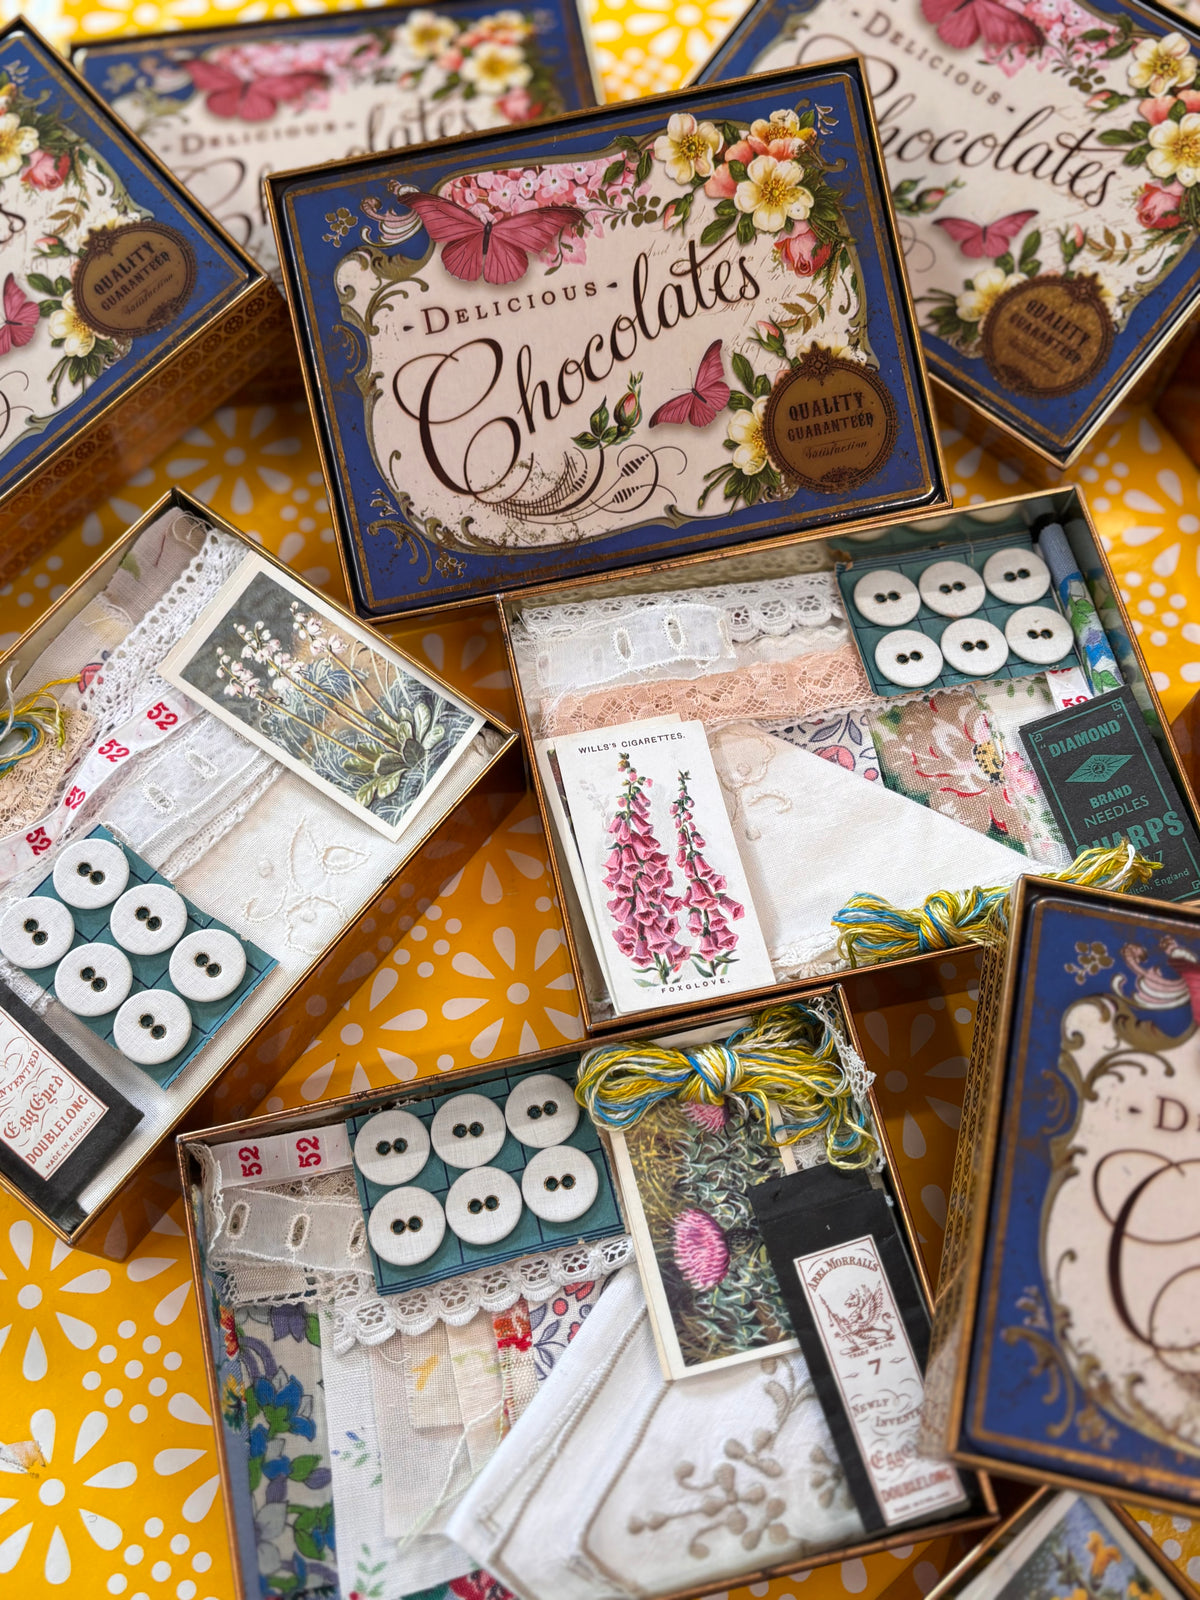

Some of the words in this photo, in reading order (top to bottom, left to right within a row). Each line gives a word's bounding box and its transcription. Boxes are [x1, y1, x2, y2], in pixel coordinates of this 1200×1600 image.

[863, 10, 1002, 106] DELICIOUS
[94, 241, 157, 296] QUALITY
[101, 251, 172, 312] GUARANTEED
[421, 281, 599, 336] DELICIOUS
[1026, 300, 1091, 348] QUALITY
[392, 232, 761, 505] Chocolates
[788, 391, 865, 422] QUALITY
[787, 411, 874, 443] GUARANTEED
[147, 702, 179, 731] 52
[98, 738, 130, 763] 52
[621, 732, 686, 748] CIGARETTES.
[65, 785, 87, 811] 52
[1083, 795, 1150, 829] NEEDLES
[1089, 784, 1133, 810] BRAND
[26, 826, 52, 857] 52
[1154, 868, 1190, 887] England
[661, 977, 731, 994] FOXGLOVE.
[0, 1050, 40, 1098] NVENTED
[25, 1094, 89, 1165] DOUBLELONG
[45, 1150, 63, 1170] MADE
[61, 1141, 70, 1152] IN
[68, 1111, 96, 1142] ENGLAND
[238, 1146, 263, 1178] 52
[296, 1136, 322, 1168] 52
[868, 1358, 881, 1375] 7
[851, 1398, 890, 1418] NEWLY
[875, 1408, 922, 1428] INVENTE
